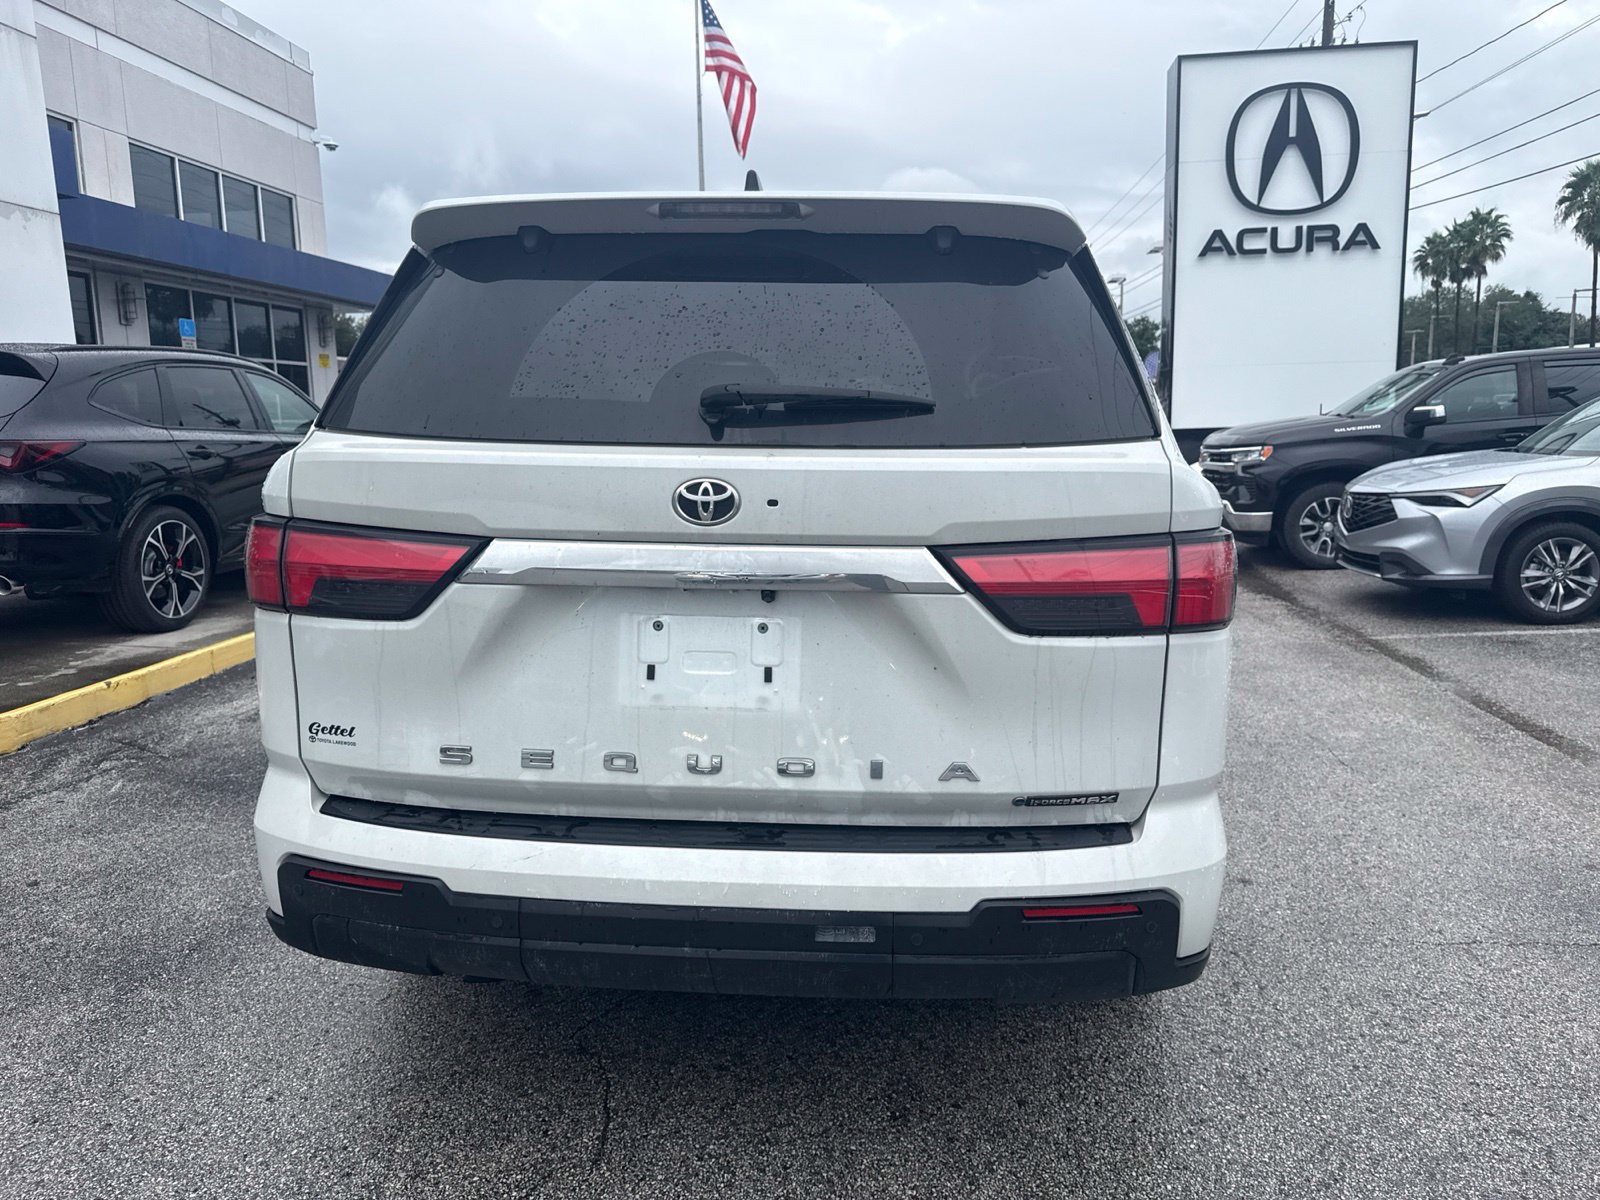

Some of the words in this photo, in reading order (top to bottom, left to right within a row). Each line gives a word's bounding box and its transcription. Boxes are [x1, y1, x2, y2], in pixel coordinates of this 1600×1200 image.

[1198, 222, 1381, 257] ACURA
[308, 721, 356, 738] Gettel
[439, 744, 981, 782] SEQUOIA
